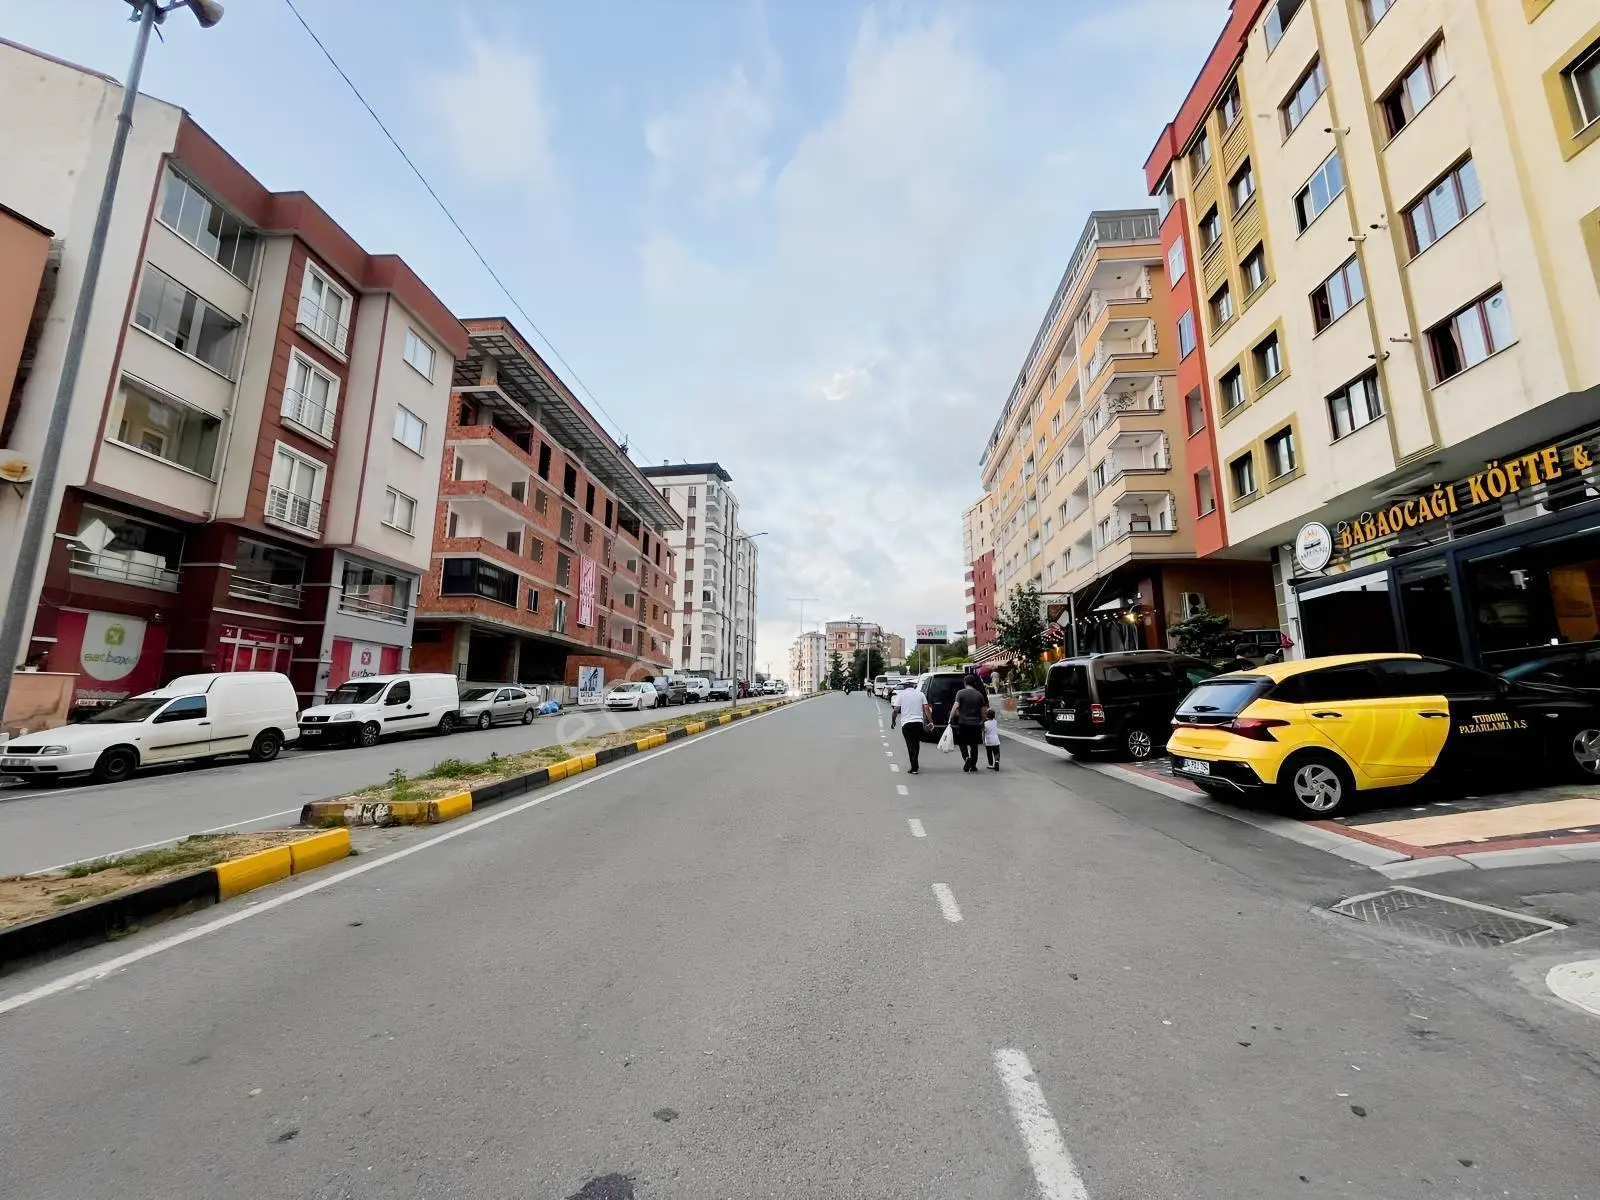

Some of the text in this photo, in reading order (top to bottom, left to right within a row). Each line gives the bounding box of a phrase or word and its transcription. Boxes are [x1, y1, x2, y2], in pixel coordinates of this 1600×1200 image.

[1341, 444, 1593, 549] BABAOCAĞI KÖFTE &
[1459, 721, 1511, 734] PAZARLAMA
